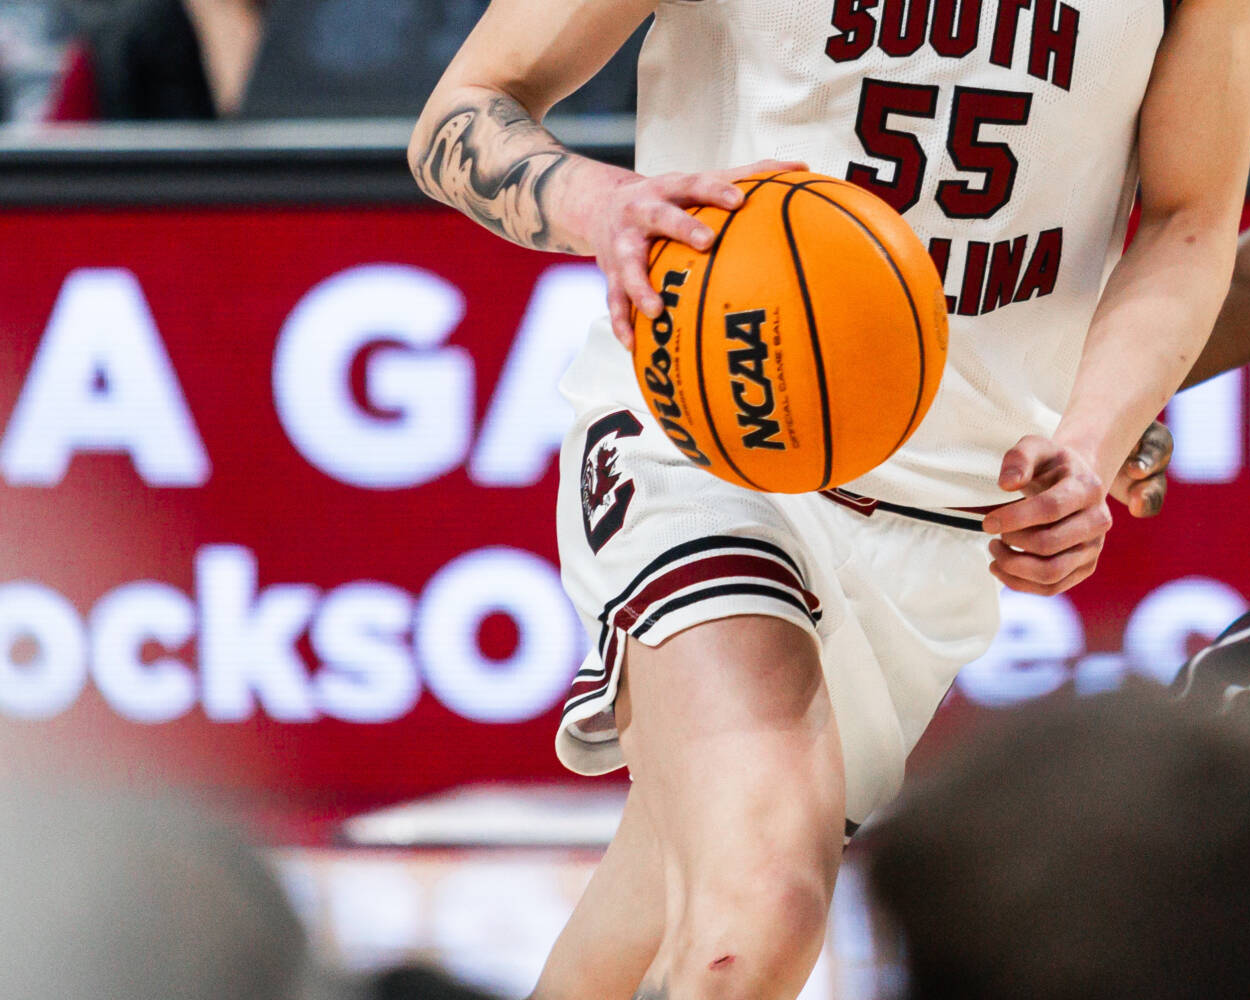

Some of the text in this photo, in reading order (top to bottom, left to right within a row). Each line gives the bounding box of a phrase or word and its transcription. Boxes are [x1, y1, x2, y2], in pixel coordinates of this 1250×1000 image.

[845, 77, 1033, 220] 55
[773, 306, 781, 346] BALL
[929, 227, 1064, 317] LINA
[0, 262, 609, 489] A GA
[645, 269, 712, 467] Wilson
[724, 308, 787, 451] NCAA
[776, 350, 787, 392] GAME
